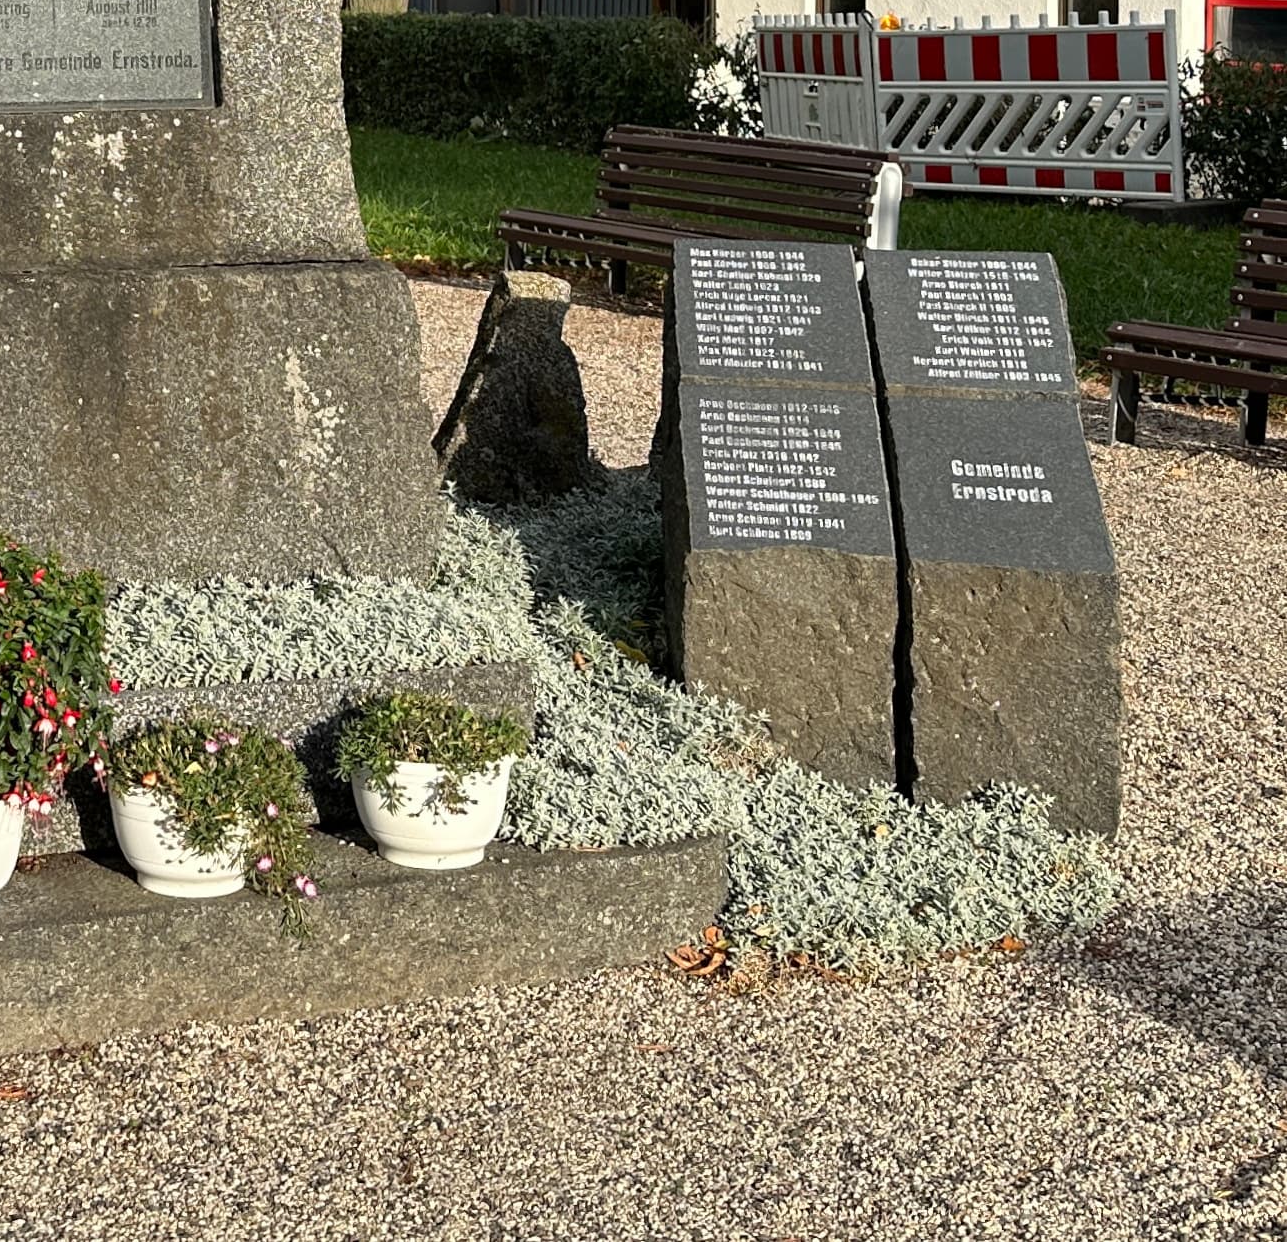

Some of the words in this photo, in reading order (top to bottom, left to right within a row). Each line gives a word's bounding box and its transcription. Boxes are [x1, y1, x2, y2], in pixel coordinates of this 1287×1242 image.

[22, 51, 102, 71] Gemeinde
[112, 49, 199, 70] Ernstroda.
[690, 258, 711, 267] Paul
[907, 268, 942, 278] Walter
[692, 279, 725, 289] Walter
[921, 279, 946, 288] Arno
[984, 281, 1010, 291] 1911
[693, 290, 719, 299] Erich
[920, 290, 942, 299] Paul
[694, 301, 726, 310] Alfred
[919, 301, 941, 310] Paul
[916, 311, 952, 321] Walter
[941, 335, 968, 344] Erich
[697, 345, 720, 354] Max
[959, 346, 996, 356] Walter
[913, 356, 954, 366] Herbert
[927, 368, 960, 378] Alfred
[698, 398, 724, 408] Arno
[699, 410, 725, 420] Arno
[702, 447, 730, 457] Erich
[952, 460, 1045, 479] Gemeinde
[704, 472, 740, 483] Robert
[705, 486, 748, 497] Werner
[952, 483, 1053, 503] Ernstroda
[706, 499, 743, 510] Walter
[746, 501, 788, 512] Schmidt
[707, 511, 734, 522] Arno
